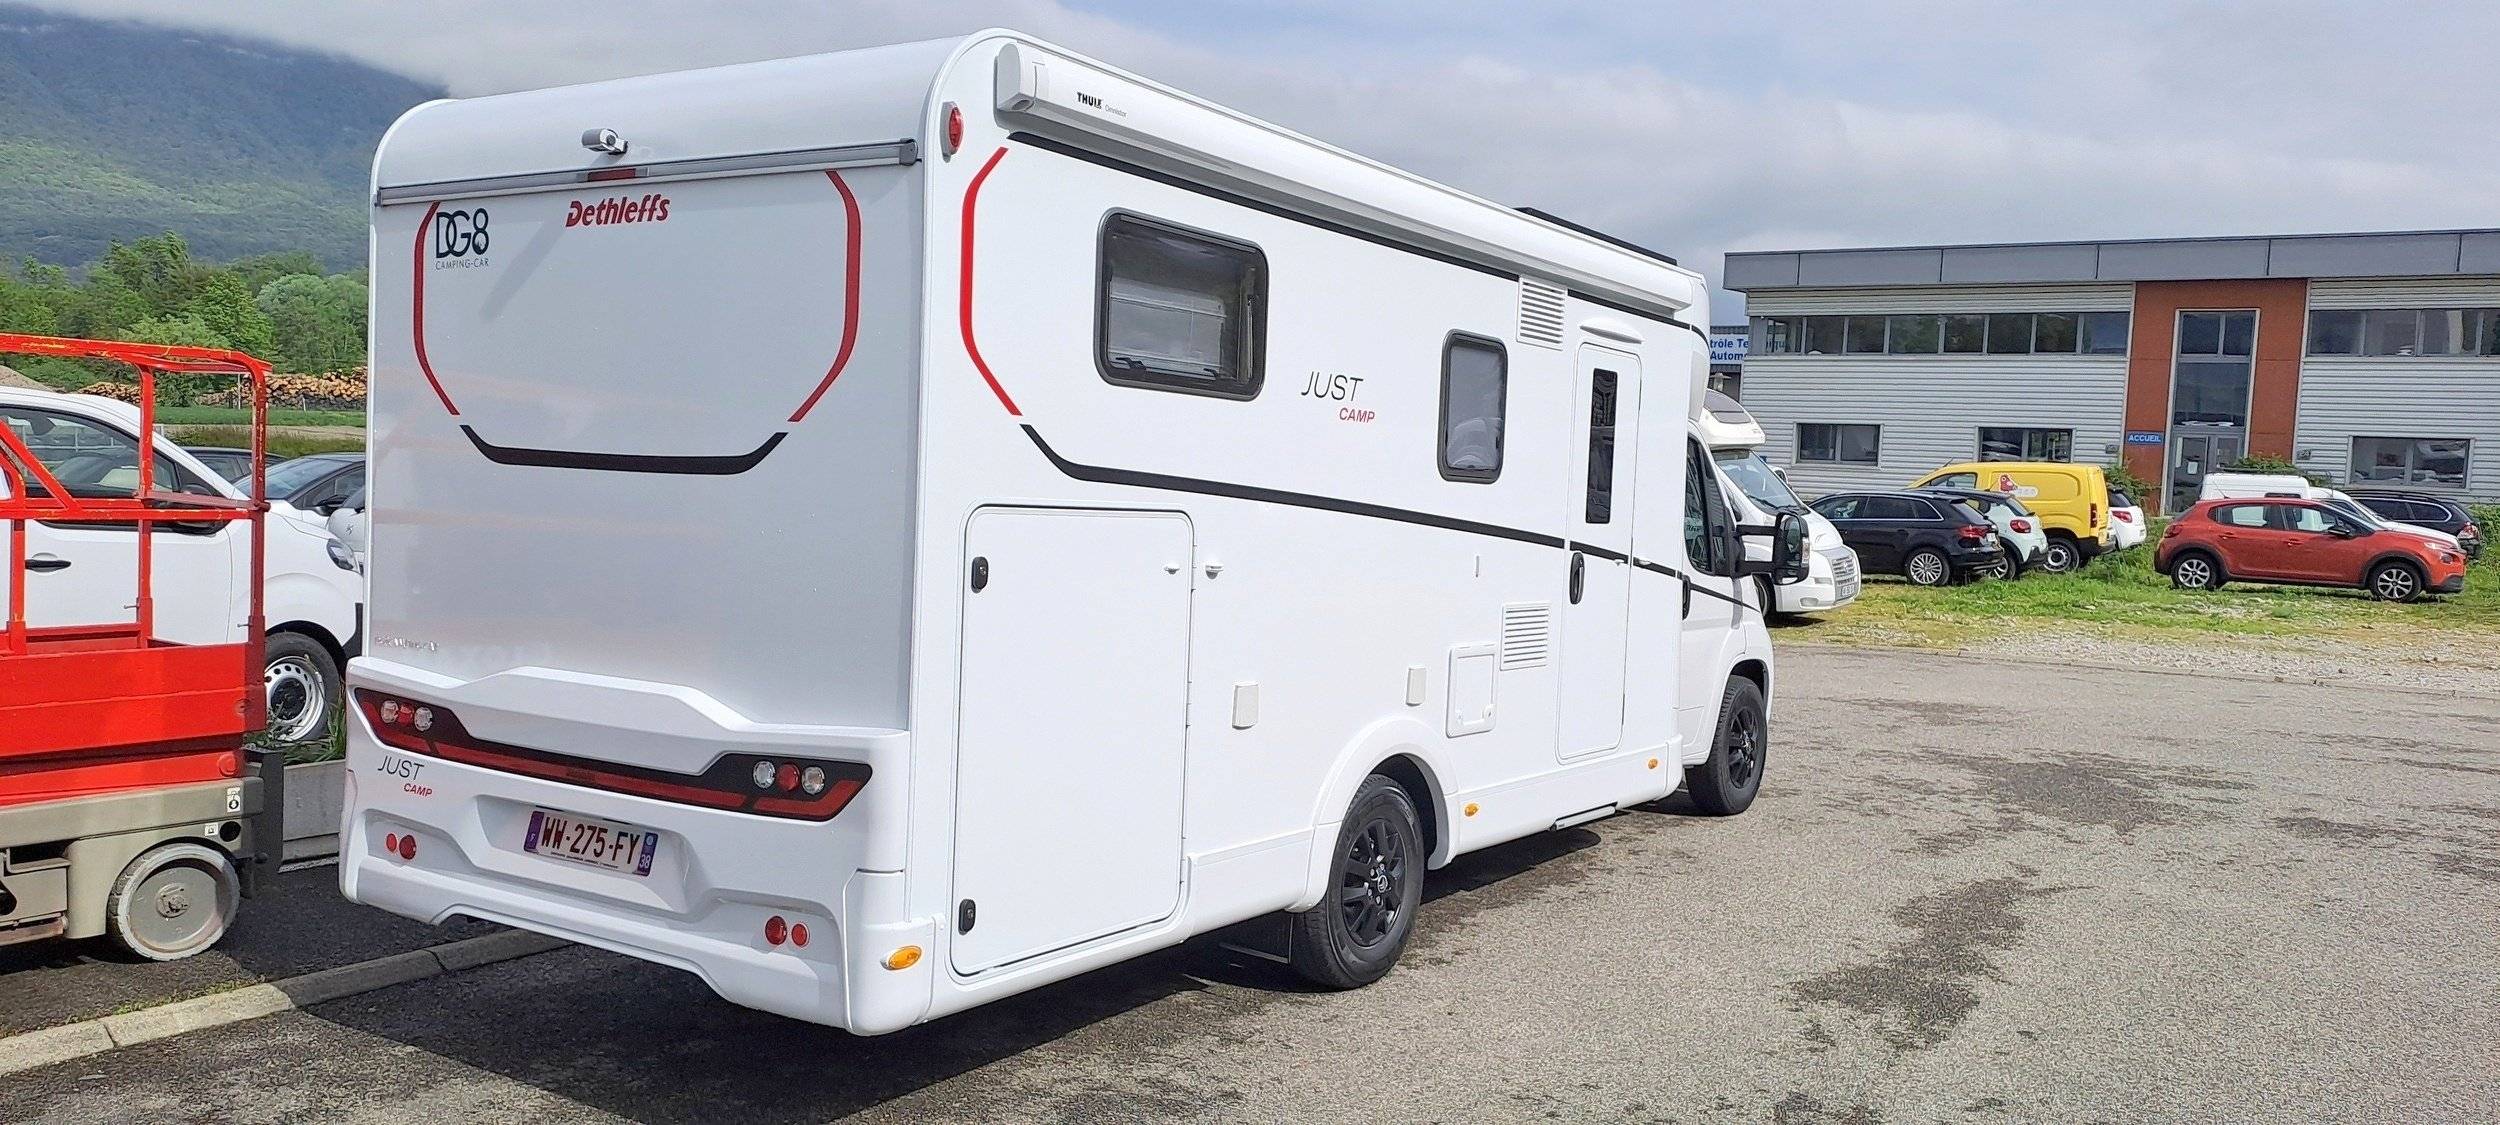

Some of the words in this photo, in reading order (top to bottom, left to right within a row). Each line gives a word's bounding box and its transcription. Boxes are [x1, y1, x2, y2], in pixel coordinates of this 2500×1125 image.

[1077, 91, 1102, 107] THULE
[565, 194, 671, 227] Dethleffs
[436, 208, 489, 258] DG8
[435, 258, 489, 270] CAMPING-CAR
[1301, 371, 1364, 401] JUST
[1339, 407, 1376, 423] CAMP
[2128, 434, 2162, 442] ACCUEIL
[377, 755, 425, 780] JUST
[403, 783, 433, 797] CAMP
[541, 816, 641, 864] WW-275-FY
[639, 854, 651, 869] 38
